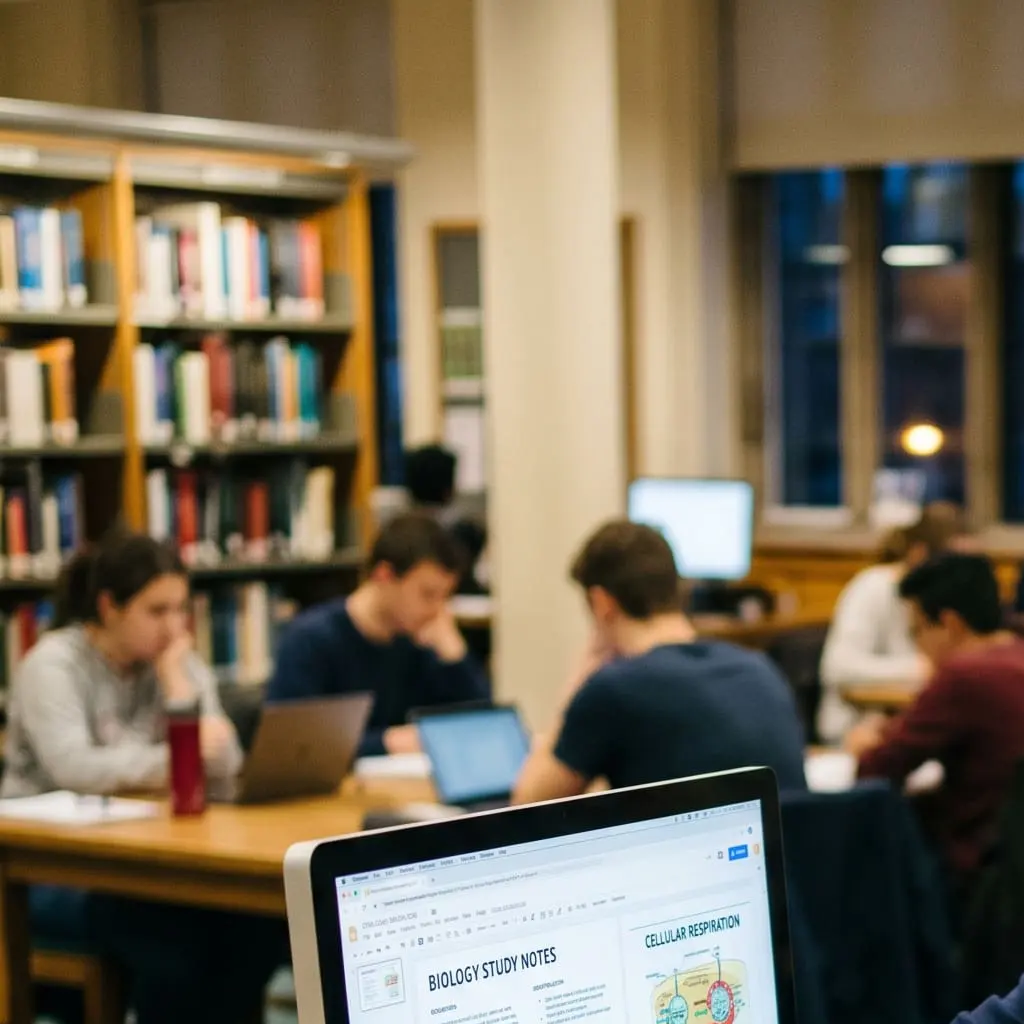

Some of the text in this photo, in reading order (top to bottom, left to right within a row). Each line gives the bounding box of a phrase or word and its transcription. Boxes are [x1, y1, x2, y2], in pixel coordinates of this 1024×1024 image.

[645, 913, 741, 949] CELLULAR RESPIRATION
[428, 946, 557, 992] BIOLOGY STUDY NOTES
